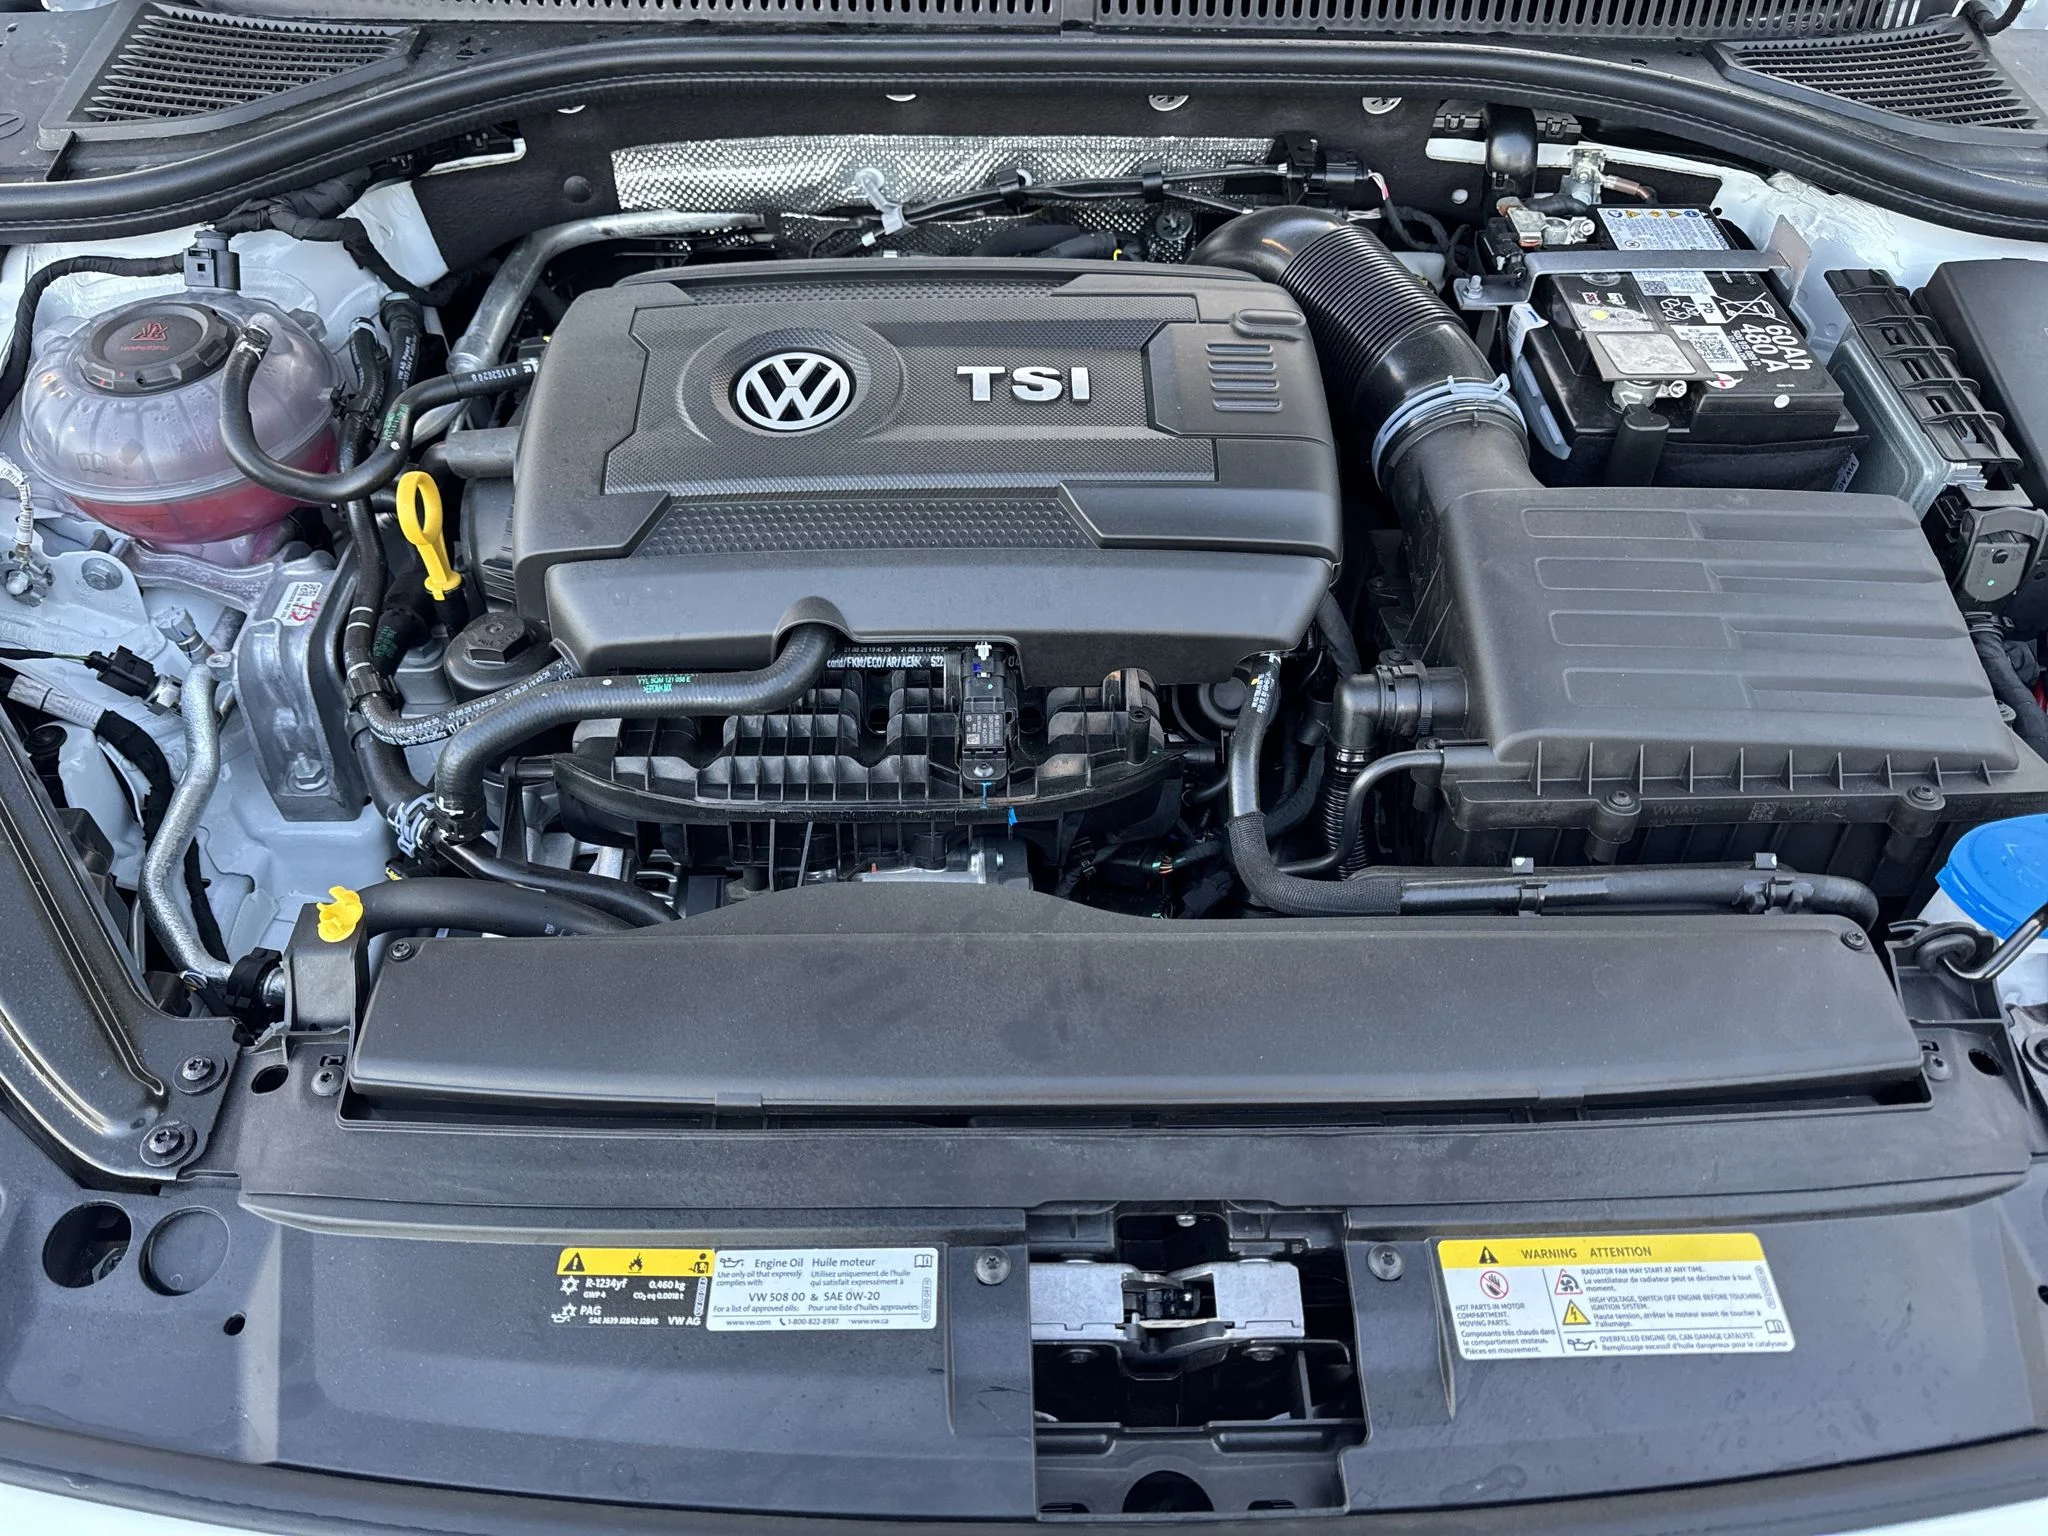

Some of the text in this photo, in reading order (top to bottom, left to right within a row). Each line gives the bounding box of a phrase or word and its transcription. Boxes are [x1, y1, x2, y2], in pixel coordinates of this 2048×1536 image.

[1698, 302, 1716, 314] Pb
[1740, 324, 1778, 354] 480
[1764, 324, 1814, 370] 60Ah
[956, 366, 1090, 402] TSI
[736, 352, 852, 432] VW
[1521, 1248, 1578, 1260] WARNING
[1590, 1246, 1652, 1258] ATTENTION
[754, 1258, 804, 1270] Engine Oil
[812, 1258, 876, 1267] Huile moteur
[730, 1270, 745, 1279] only
[746, 1270, 756, 1278] oil
[756, 1270, 770, 1278] that
[771, 1270, 802, 1279] expressly
[810, 1270, 836, 1278] Utilisez
[837, 1270, 879, 1278] uniquement
[584, 1278, 628, 1292] R-1234yf
[716, 1278, 763, 1288] complies with
[810, 1278, 822, 1288] qui
[822, 1278, 850, 1286] satisfait
[850, 1278, 898, 1286] expressément
[1593, 1276, 1629, 1284] ventilateur
[1670, 1276, 1686, 1284] peut
[648, 1279, 686, 1292] 0.460 kg
[748, 1292, 880, 1302] VW 508 00 & SAE 0W-20
[580, 1306, 602, 1316] PAG
[751, 1305, 784, 1314] approved
[808, 1304, 824, 1312] Pour
[1500, 1302, 1525, 1310] MOTOR
[668, 1316, 702, 1326] VW AG
[1460, 1330, 1501, 1338] Composants
[1502, 1328, 1515, 1336] très
[1516, 1328, 1540, 1336] chauds
[1470, 1338, 1519, 1347] compartiment
[1599, 1335, 1640, 1343] OVERFILLED
[1640, 1334, 1666, 1342] ENGINE
[1464, 1346, 1487, 1355] Pièces
